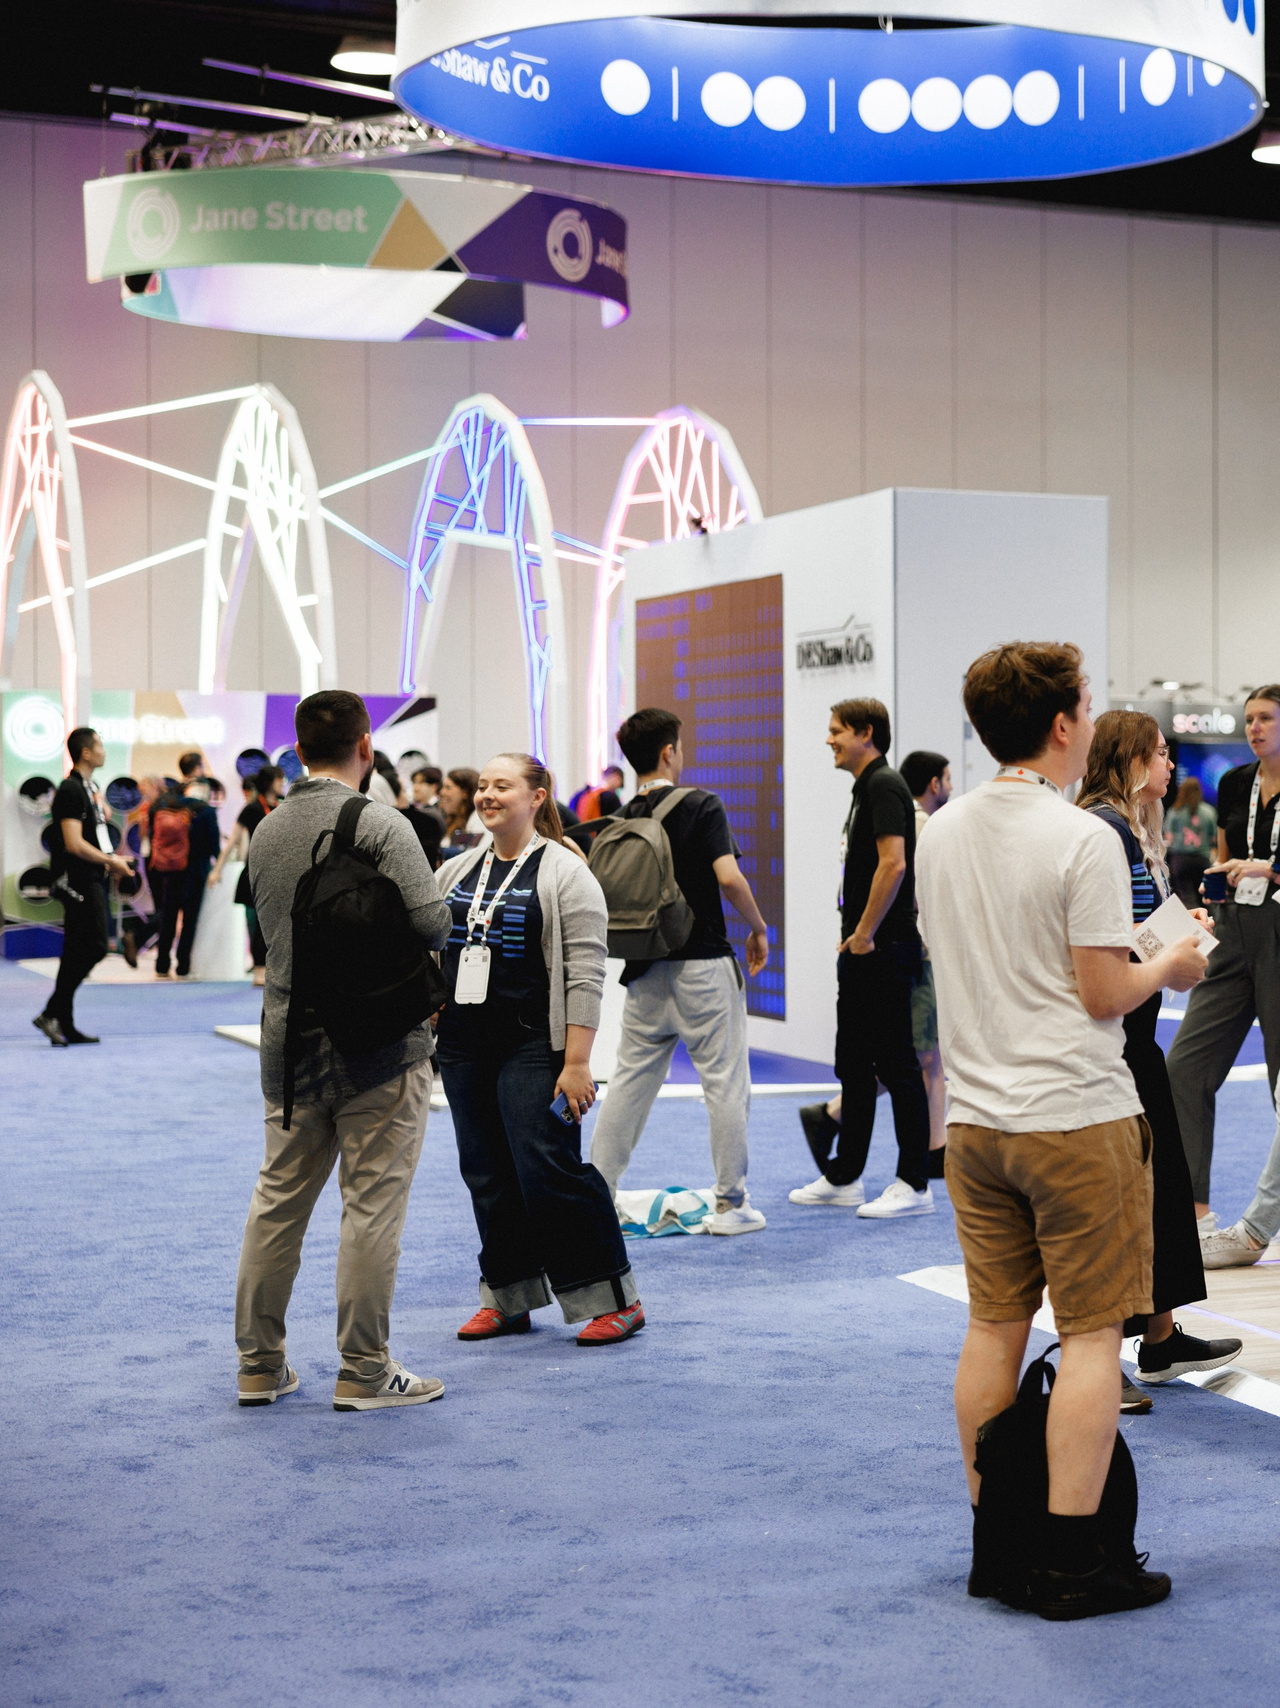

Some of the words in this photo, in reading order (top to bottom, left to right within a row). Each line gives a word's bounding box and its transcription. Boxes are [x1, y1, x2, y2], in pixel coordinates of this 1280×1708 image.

[189, 203, 259, 233] Jane
[264, 201, 368, 233] Street
[1172, 707, 1236, 734] scale
